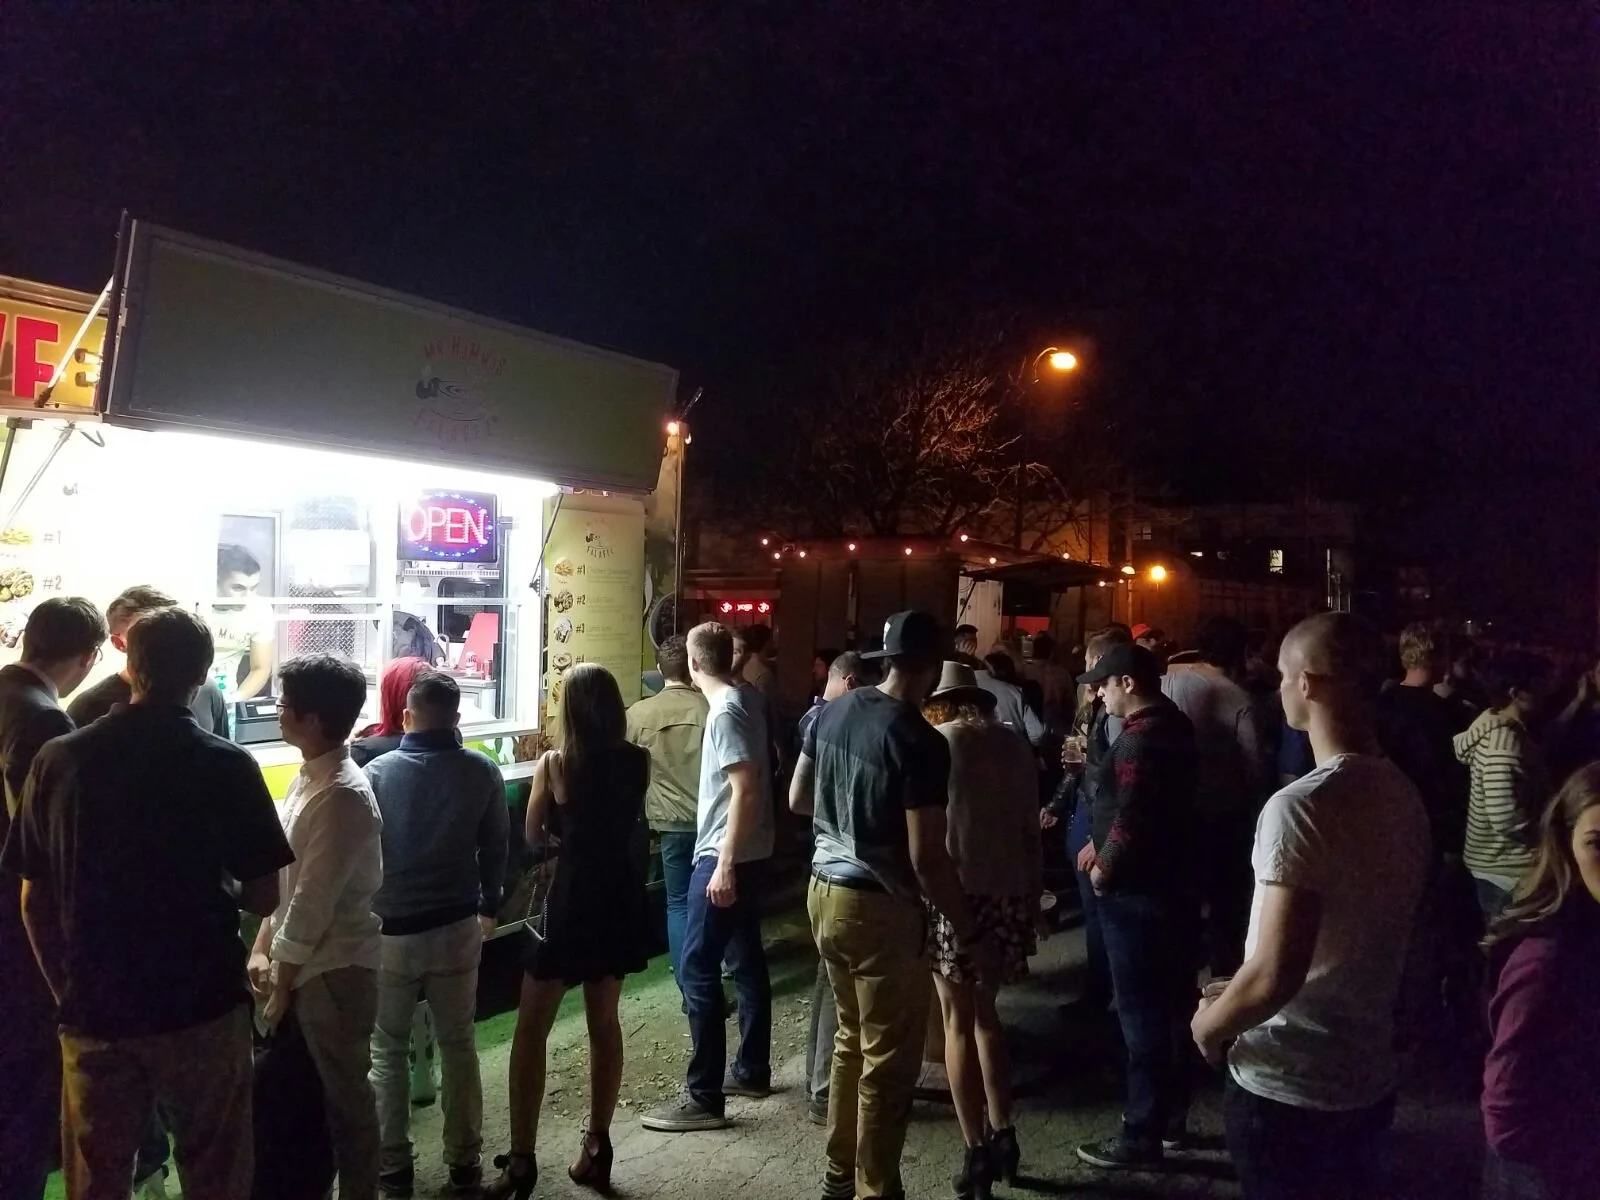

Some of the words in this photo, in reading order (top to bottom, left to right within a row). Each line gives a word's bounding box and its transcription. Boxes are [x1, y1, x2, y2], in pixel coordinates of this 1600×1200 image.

[406, 506, 488, 544] OPEN
[43, 530, 61, 544] #1
[576, 564, 586, 575] #1
[43, 575, 62, 590] #2
[576, 594, 586, 605] #2
